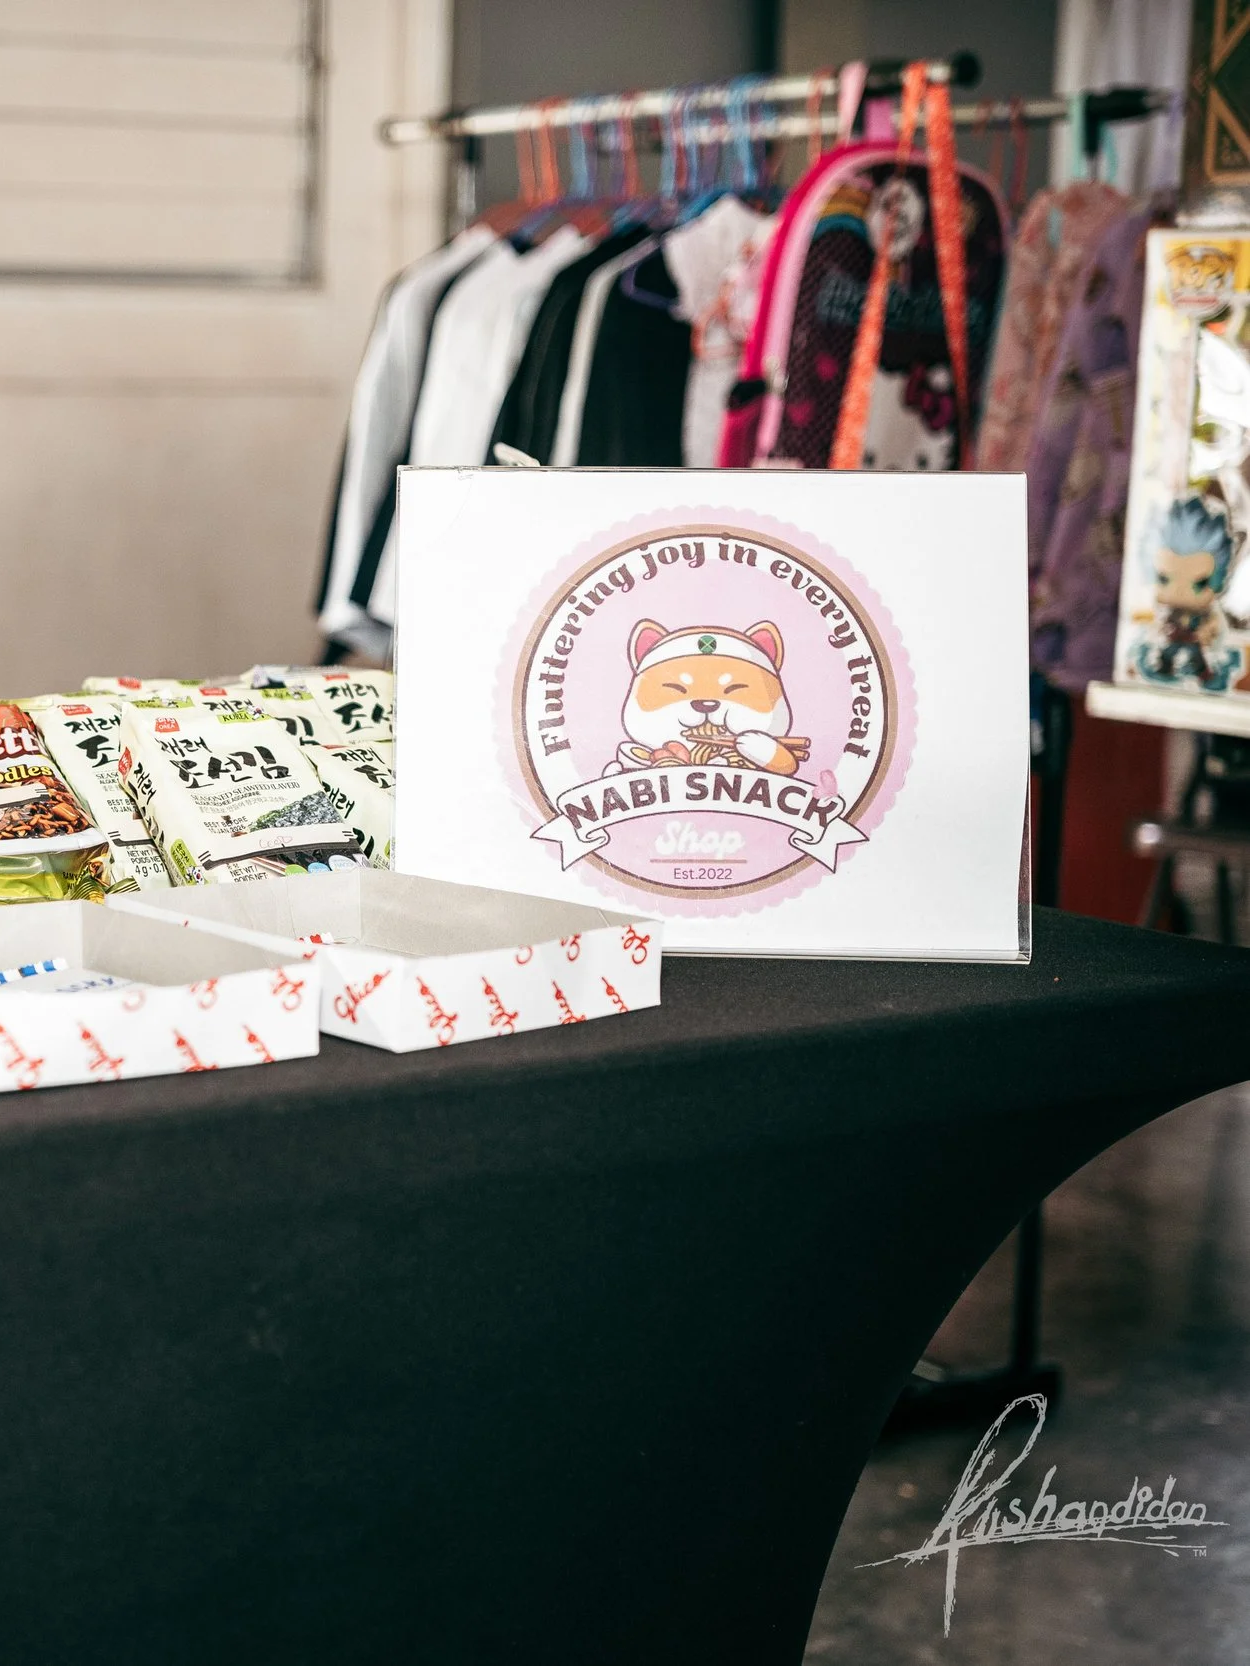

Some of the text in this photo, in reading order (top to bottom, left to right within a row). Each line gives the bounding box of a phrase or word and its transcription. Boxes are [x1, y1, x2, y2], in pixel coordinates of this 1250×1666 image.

[538, 541, 874, 759] Fluttering joy in every treat
[170, 746, 292, 789] 조선김
[564, 772, 839, 830] NABI SNACK
[654, 820, 746, 859] Shop
[673, 866, 733, 881] Est.2022
